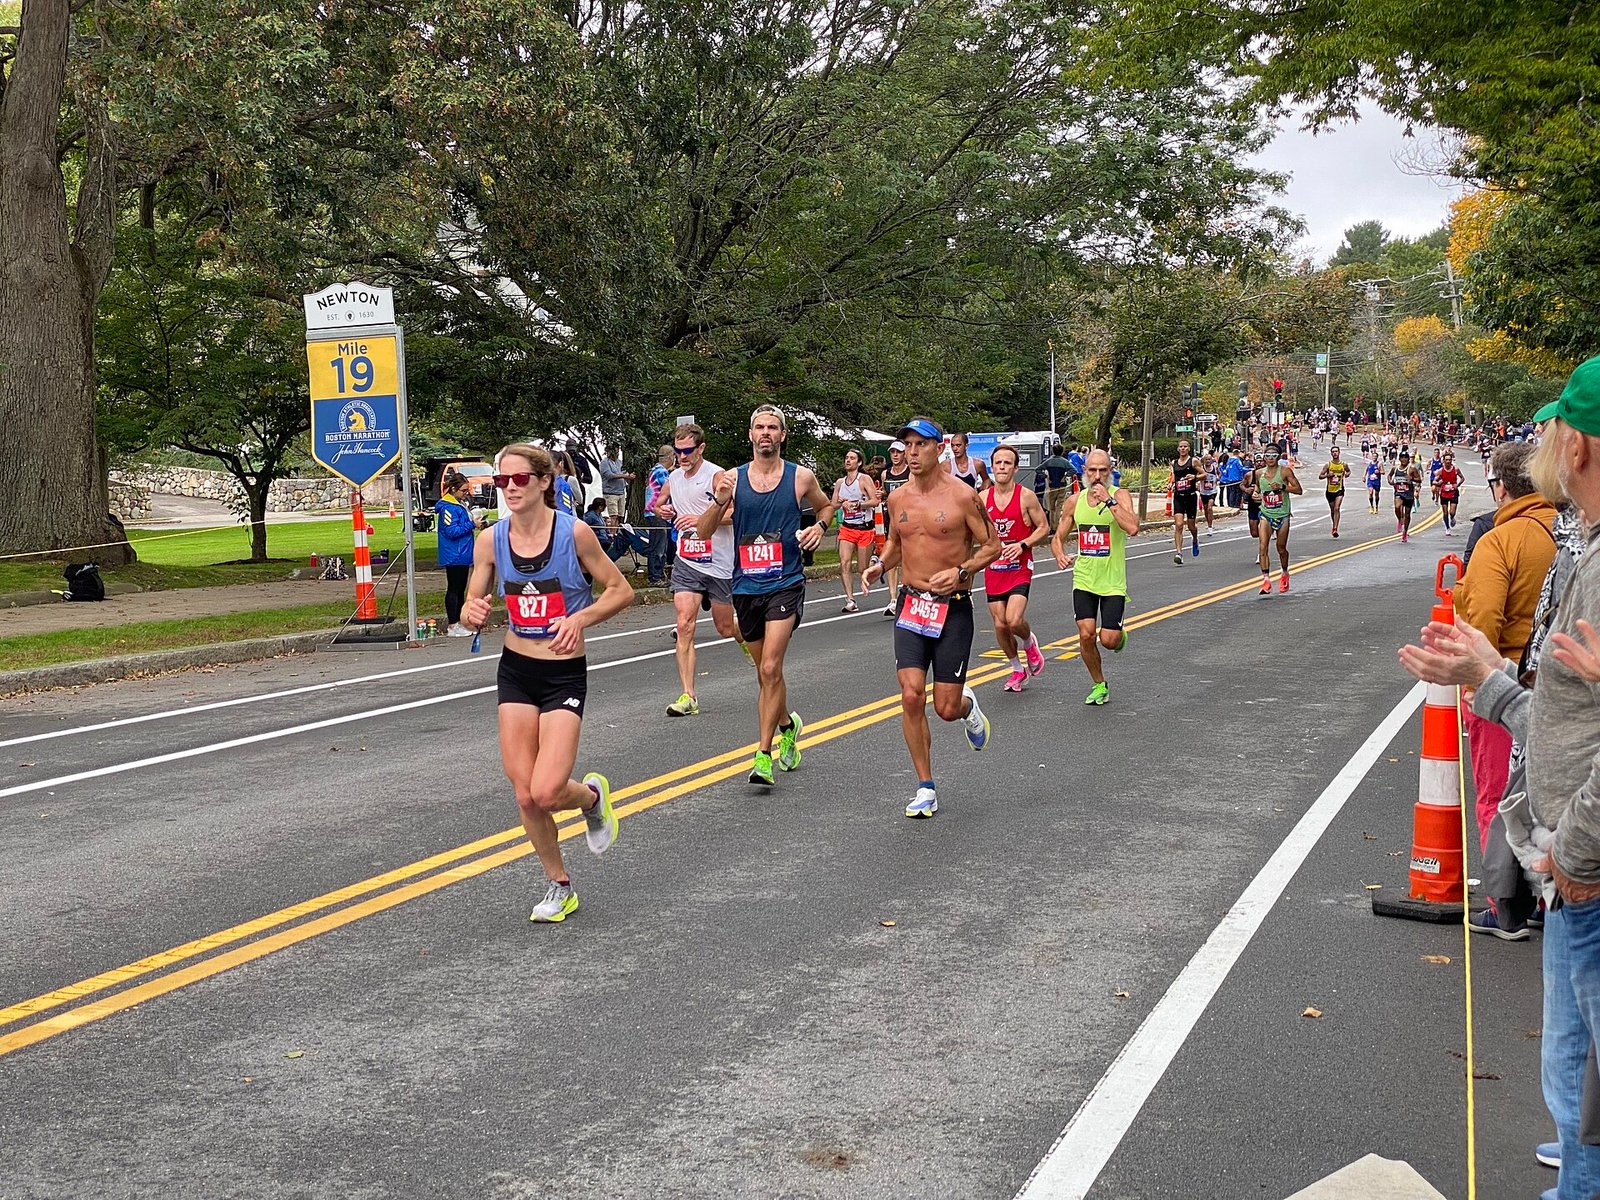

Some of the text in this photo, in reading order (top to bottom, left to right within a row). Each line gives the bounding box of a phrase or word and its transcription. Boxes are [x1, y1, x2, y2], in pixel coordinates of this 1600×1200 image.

[316, 291, 379, 310] NEWTON
[338, 342, 368, 356] Mile
[330, 356, 374, 394] 19
[325, 431, 390, 441] BOSTON MARATHON
[684, 540, 706, 552] 2855
[1083, 533, 1104, 545] 1474
[747, 545, 774, 561] 1241
[517, 595, 547, 618] 827
[910, 598, 940, 621] 3455
